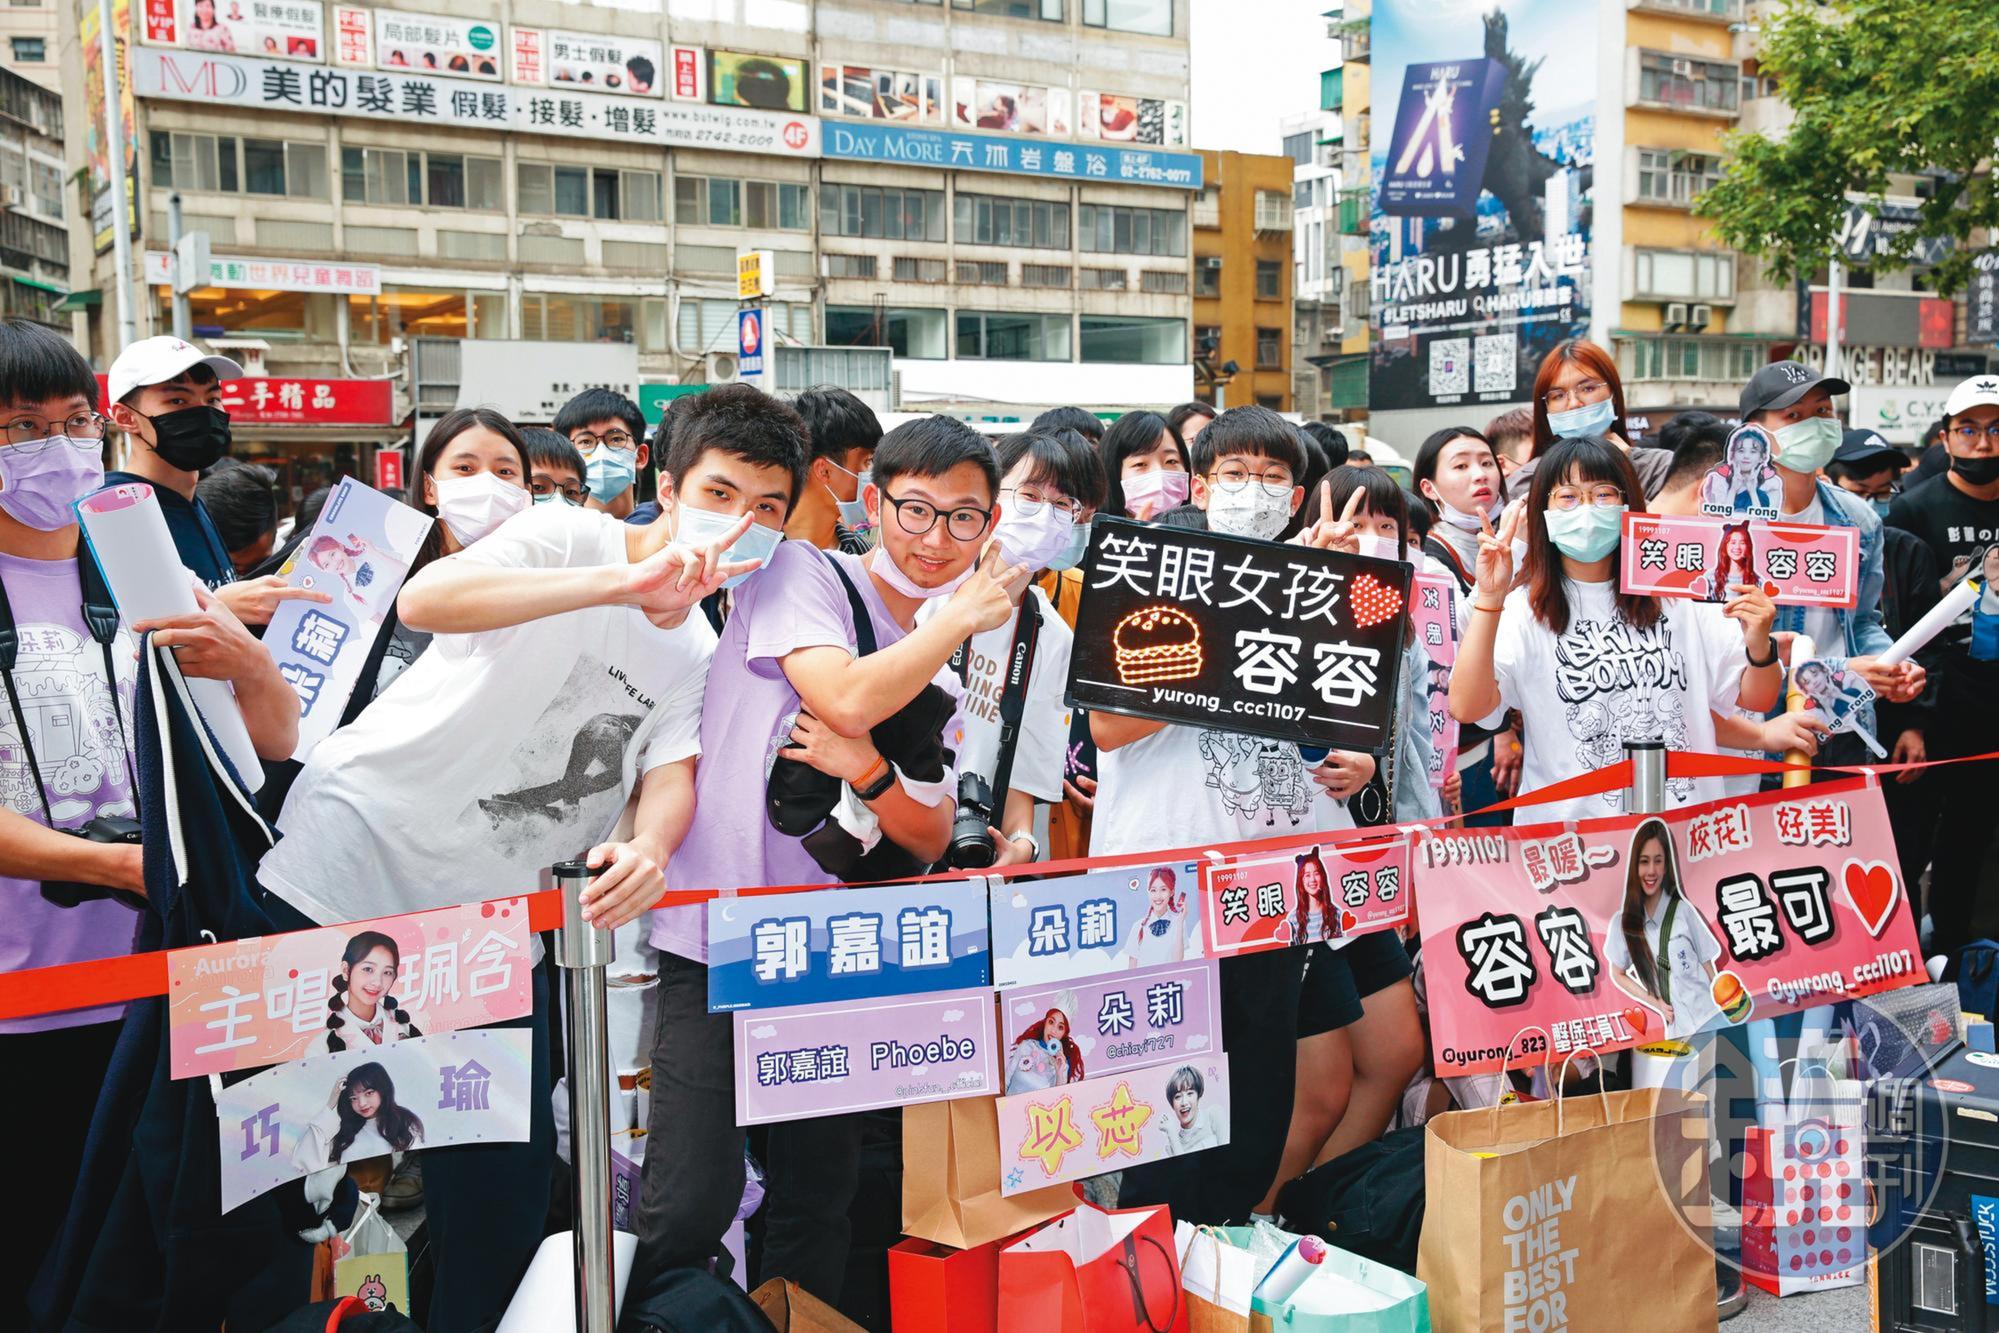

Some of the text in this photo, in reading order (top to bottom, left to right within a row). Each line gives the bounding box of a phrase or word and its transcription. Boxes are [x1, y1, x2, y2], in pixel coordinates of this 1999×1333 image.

[383, 22, 462, 47] 局部髮片
[553, 42, 623, 66] 男士假髮
[262, 65, 438, 117] 美的髮業
[695, 129, 775, 147] 2742-2009
[835, 131, 943, 162] DAY MORE
[951, 141, 1107, 177] 天沐岩盤浴
[1371, 233, 1586, 302] HARU 勇猛入世
[1384, 299, 1467, 323] #LETSHARU
[1793, 345, 1936, 386] ORNGE BEAR
[221, 381, 336, 410] 二手精品
[1638, 525, 1671, 536] 19991107
[1704, 504, 1778, 520] rong rong
[1092, 533, 1344, 626] 笑眼女孩
[1639, 539, 1837, 582] 笑眼 容容
[1421, 586, 1443, 646] 笑眼
[1011, 641, 1027, 686] Canon
[1232, 628, 1381, 708] 容容
[1556, 648, 1687, 704] BOTTOM
[1152, 686, 1306, 723] yurong_ccc1107
[1850, 689, 1875, 712] rong
[1818, 718, 1842, 742] rng
[1419, 835, 1509, 868] 19991107
[1688, 802, 1849, 859] 校花! 好美!
[1216, 871, 1248, 883] 19991107
[1220, 866, 1400, 926] 笑眼 容容
[1029, 898, 1117, 957] 朵莉
[1718, 869, 1833, 959] 最可
[195, 948, 271, 977] Aurora
[754, 908, 951, 983] 郭嘉誼
[1460, 908, 1597, 1005] 容容
[195, 930, 518, 1055] 主唱 珮含
[1099, 981, 1183, 1036] 朵莉
[756, 1034, 976, 1087] 郭嘉誼 Phoebe
[1106, 1034, 1175, 1059] @chiayi727
[438, 1058, 492, 1112] 瑜
[240, 1102, 281, 1162] 巧
[1032, 1105, 1135, 1153] 以芯
[1503, 1175, 1578, 1231] ONLY
[1503, 1218, 1559, 1269] THE
[1504, 1247, 1580, 1305] BEST
[1504, 1291, 1568, 1333] FOR
